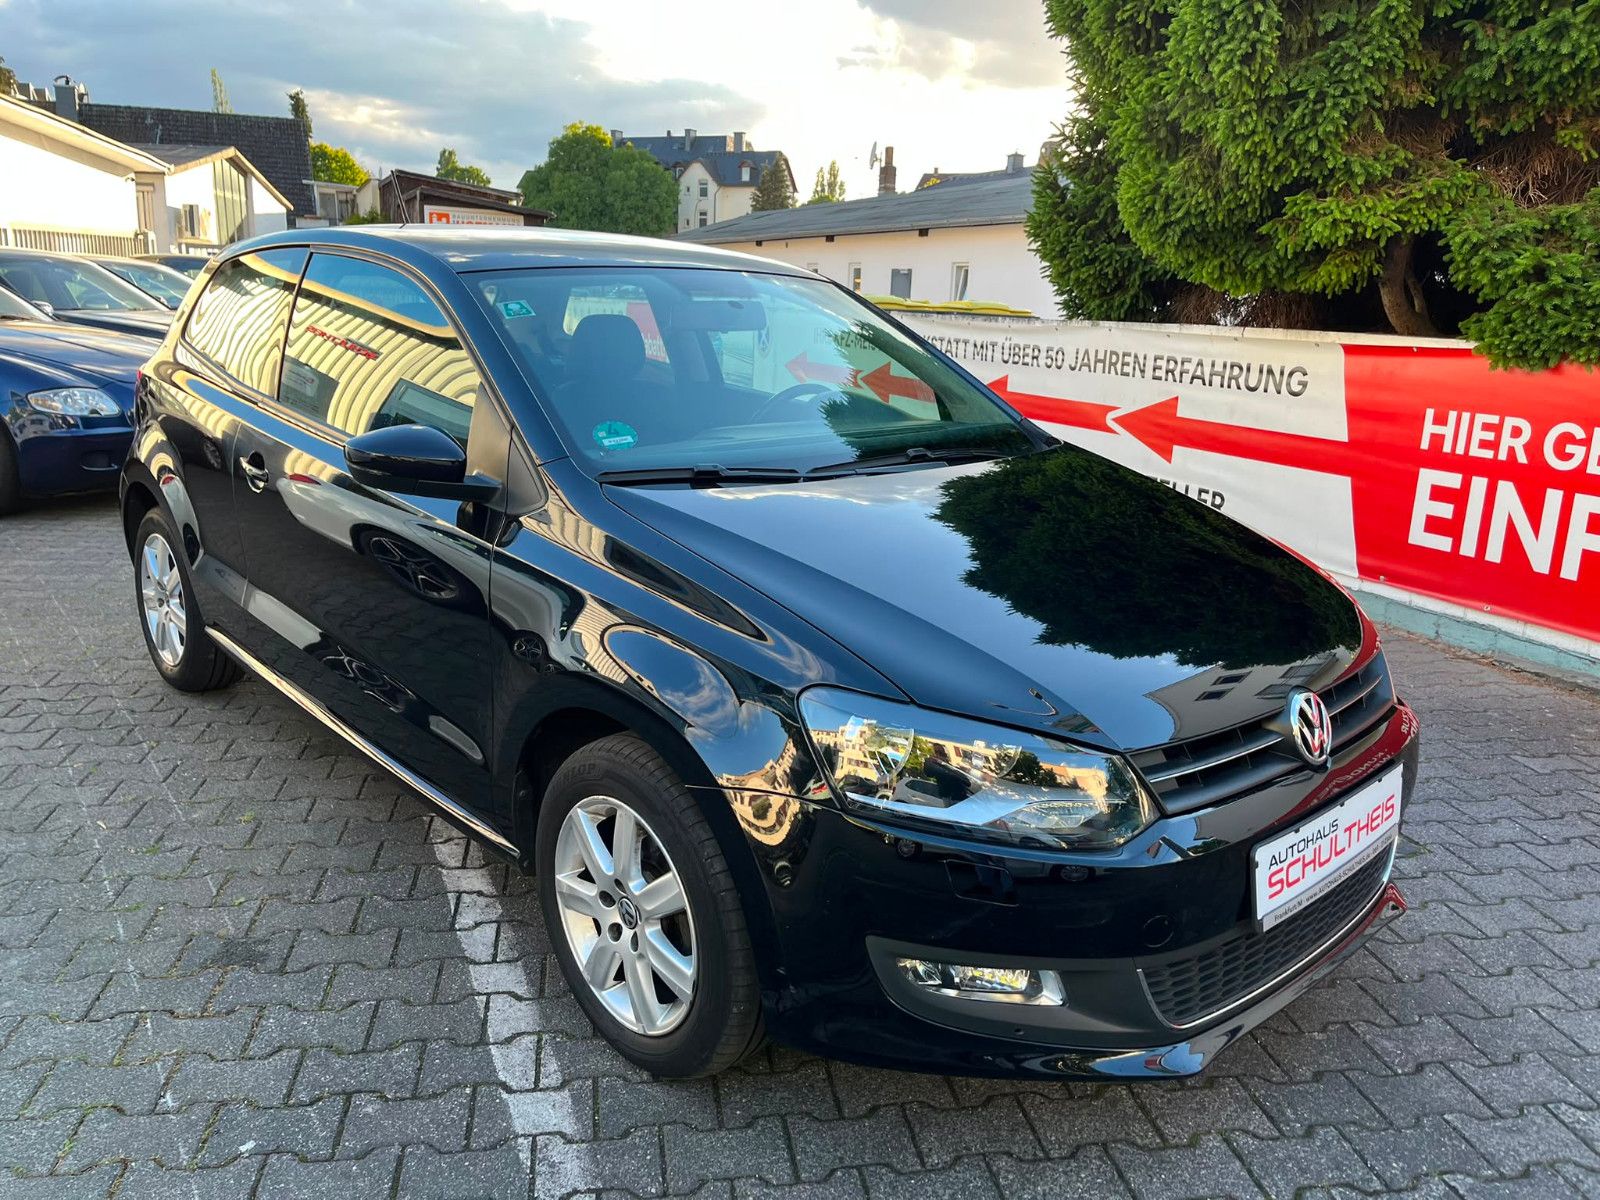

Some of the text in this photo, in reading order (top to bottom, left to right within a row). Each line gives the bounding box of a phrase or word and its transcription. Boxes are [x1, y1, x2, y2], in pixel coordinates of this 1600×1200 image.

[972, 339, 998, 362] MIT
[1001, 336, 1041, 367] ÜBER
[1045, 346, 1065, 370] 50
[1069, 348, 1147, 379] JAHREN
[1151, 354, 1309, 397] ERFAHRUNG
[1420, 407, 1532, 464] HIER
[1267, 794, 1396, 900] SCHULTHEIS
[1268, 818, 1339, 870] AUTOHAUS
